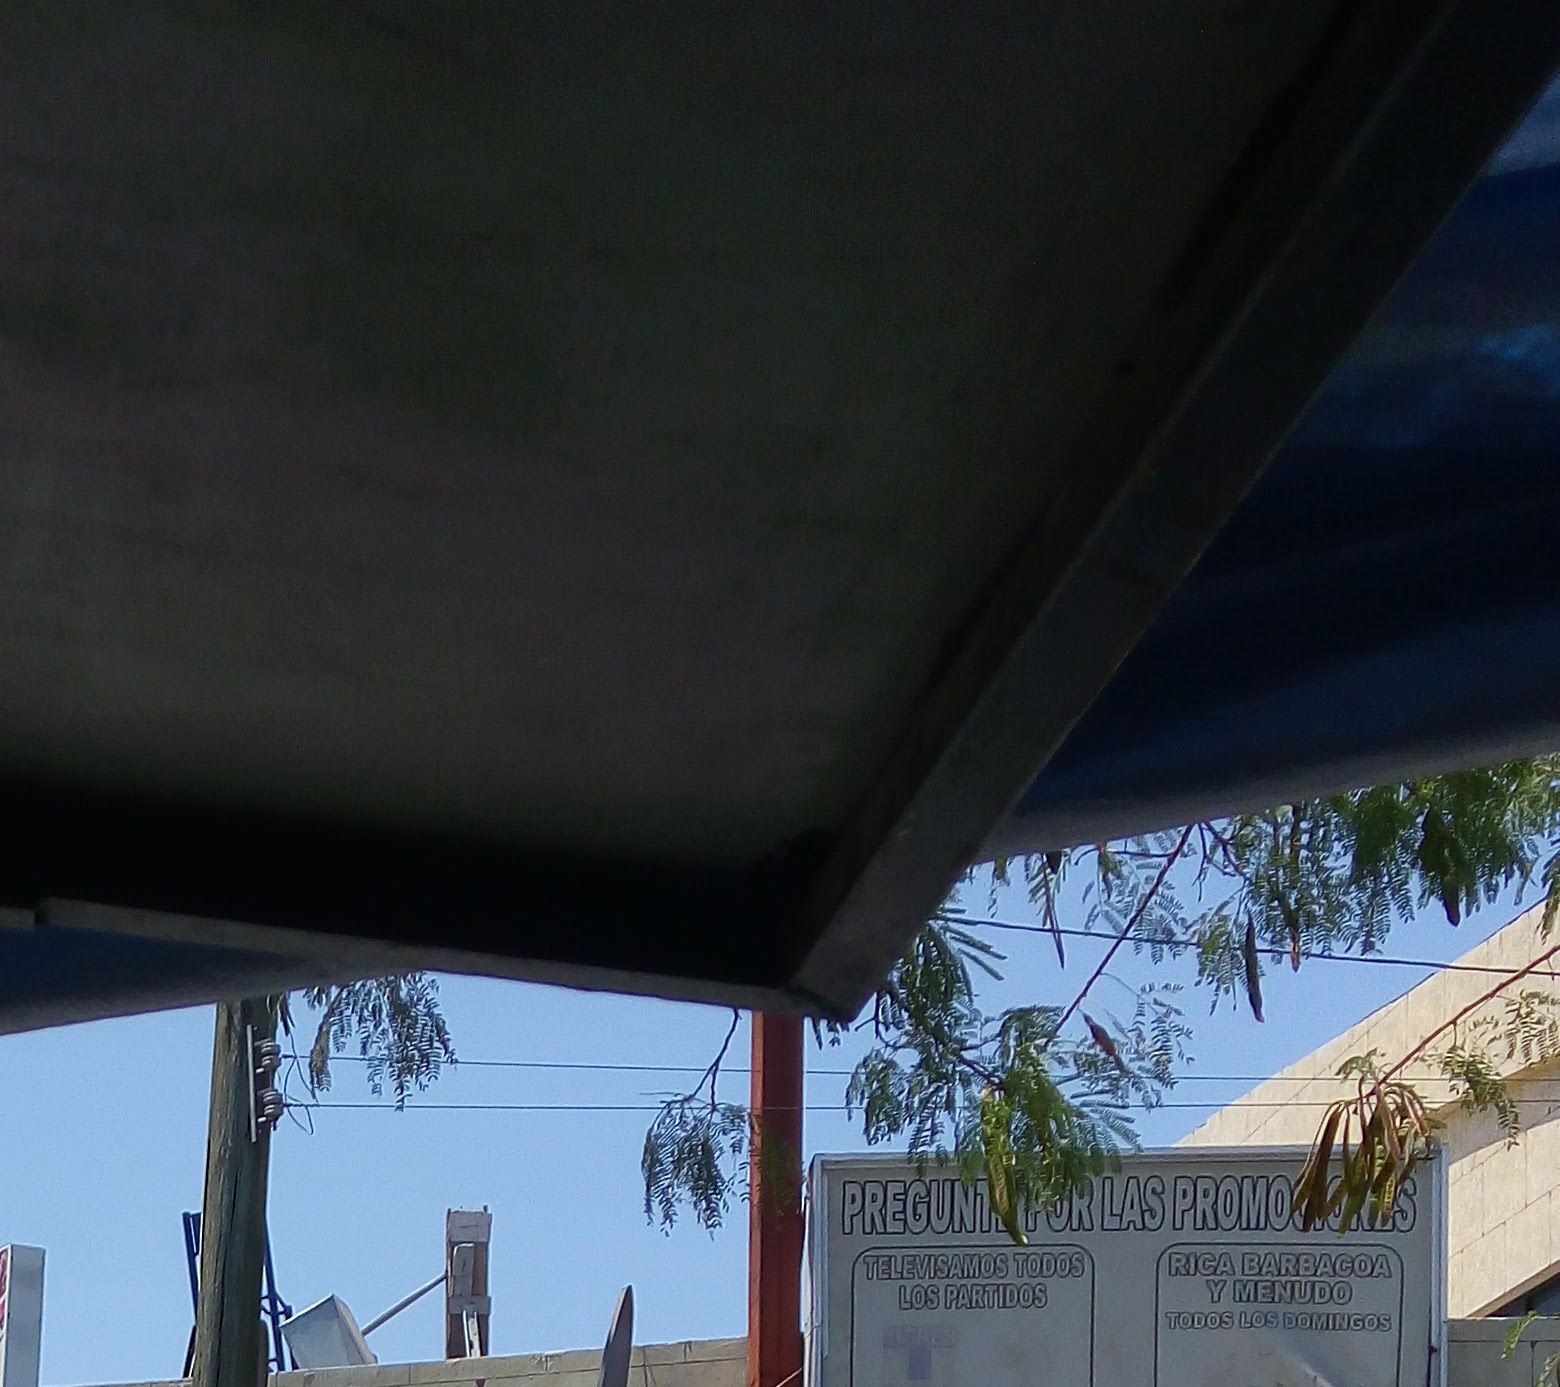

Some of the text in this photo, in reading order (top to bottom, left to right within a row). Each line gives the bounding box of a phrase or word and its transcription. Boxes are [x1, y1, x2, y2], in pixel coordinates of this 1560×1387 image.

[842, 1177, 1016, 1235] PREGUNT
[1101, 1174, 1166, 1233] LAS
[1173, 1173, 1418, 1234] PROMOS
[862, 1251, 1085, 1280] TELEVISAMOS TODOS
[1168, 1252, 1393, 1279] RICA BARBACOA
[898, 1283, 1049, 1311] LOS PARTIDOS
[1205, 1278, 1354, 1306] Y MENUDO
[1165, 1310, 1393, 1332] TODOS LOS DOMINGOS
